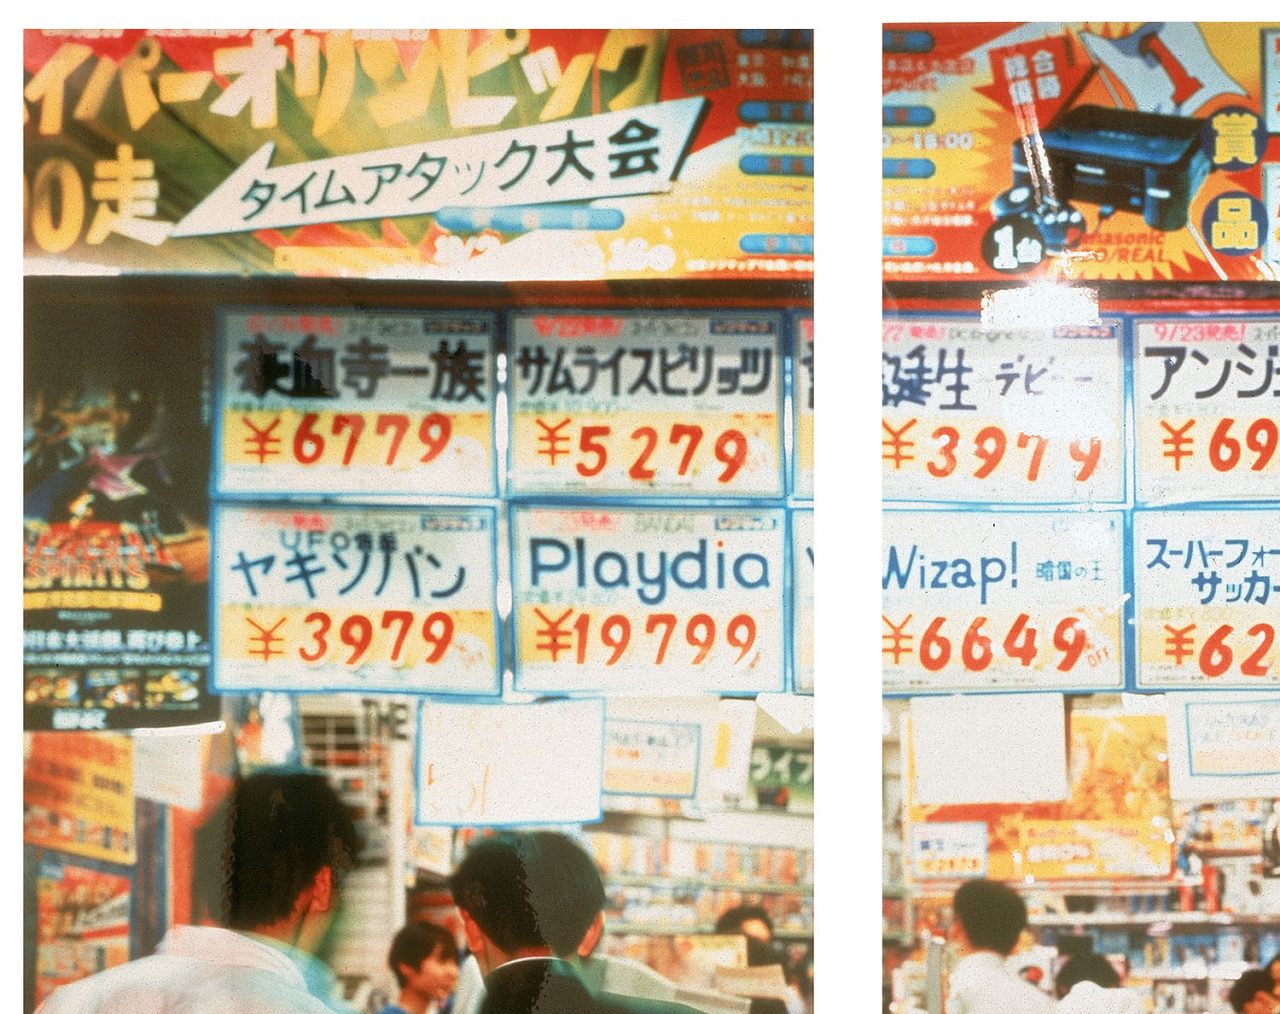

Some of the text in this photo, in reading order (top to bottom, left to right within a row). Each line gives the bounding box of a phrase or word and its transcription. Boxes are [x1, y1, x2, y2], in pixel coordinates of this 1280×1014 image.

[241, 118, 660, 222] タイムアタック大会
[241, 412, 453, 466] ¥6779
[535, 416, 748, 483] ¥5279
[231, 551, 466, 599] ヤキソバン
[530, 536, 770, 605] Playdia
[246, 610, 455, 665] ¥3979
[534, 607, 758, 666] ¥19799
[882, 613, 1087, 672] ¥6649
